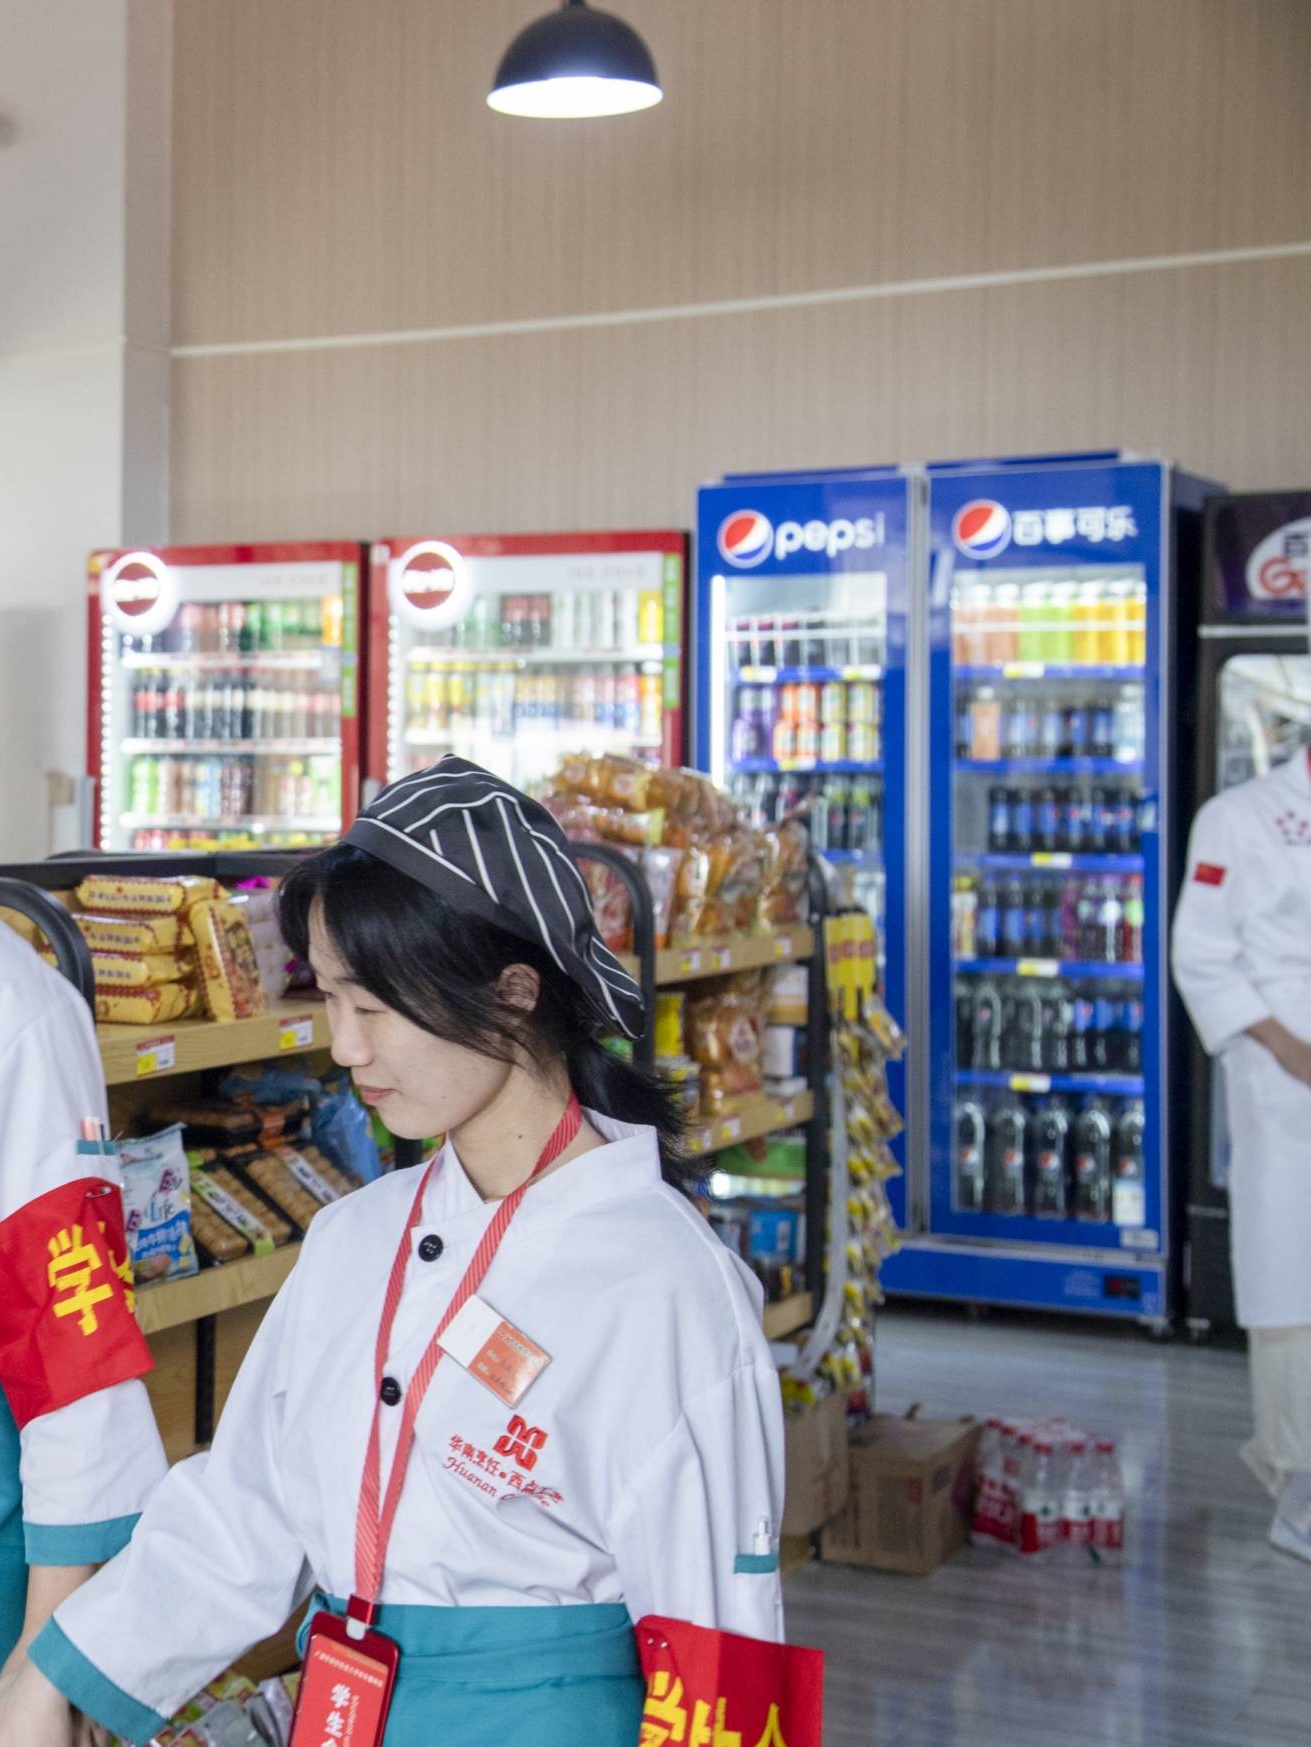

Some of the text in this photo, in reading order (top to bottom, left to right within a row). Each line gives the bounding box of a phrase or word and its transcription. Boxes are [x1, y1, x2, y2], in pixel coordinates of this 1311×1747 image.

[775, 511, 884, 560] pepsi
[1012, 505, 1138, 545] 百事可乐
[443, 1456, 498, 1498] Huanan
